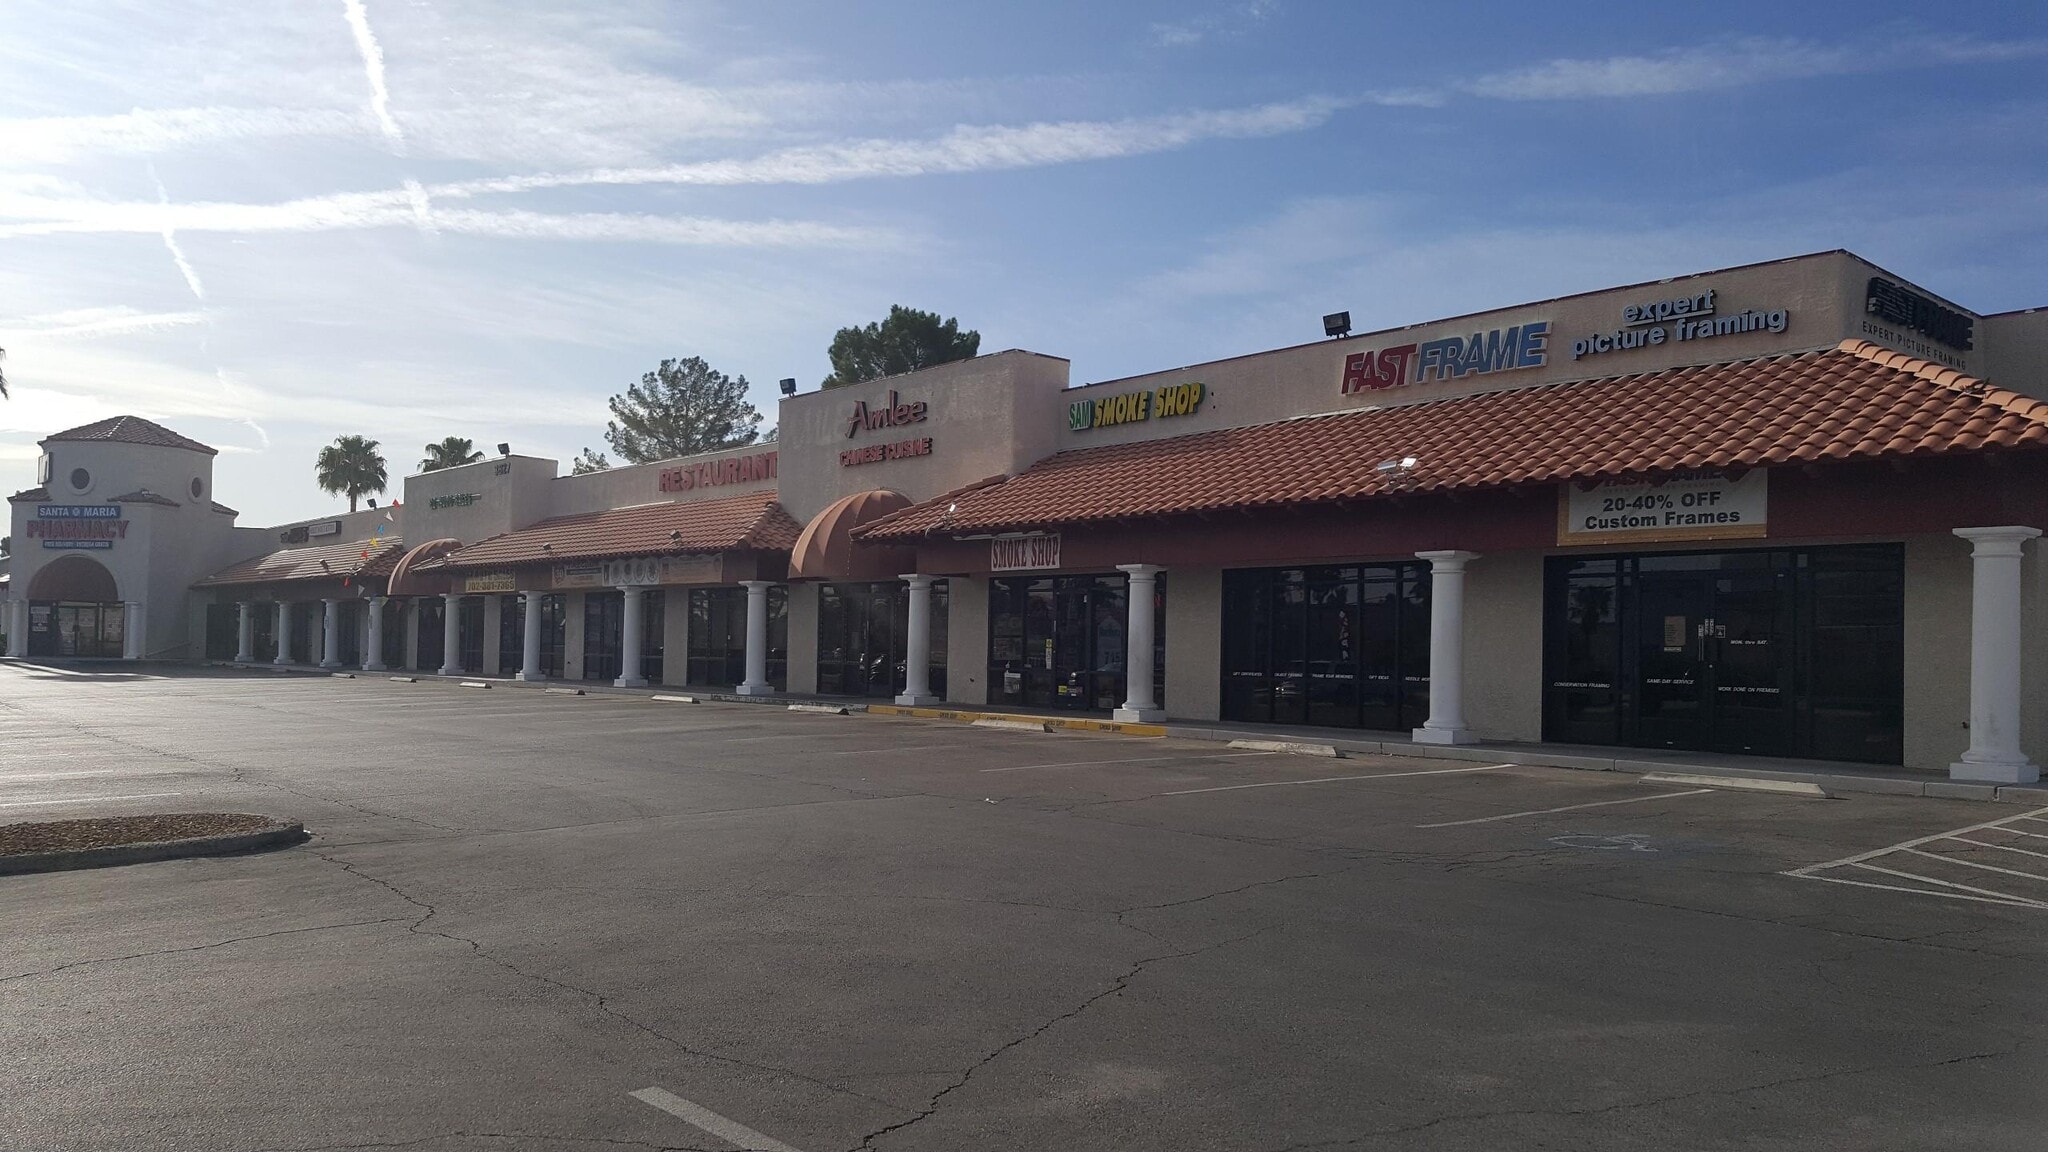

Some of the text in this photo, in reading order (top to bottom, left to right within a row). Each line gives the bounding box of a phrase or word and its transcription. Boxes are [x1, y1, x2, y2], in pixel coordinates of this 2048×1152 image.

[1622, 288, 1715, 321] expert
[1572, 308, 1789, 360] picture framing
[1862, 321, 1966, 370] EXPERT PICTURE FRAMING
[844, 389, 928, 439] Amlee
[1069, 382, 1204, 431] SAM SMOKE SHOP
[885, 437, 933, 460] CUISINE
[658, 451, 778, 492] RESTAURANT
[39, 507, 117, 517] SANTA MARIA
[1602, 491, 1721, 512] 20-40% OFF
[26, 519, 130, 540] PHARMACY
[1585, 511, 1741, 530] Custom Frames
[992, 535, 1059, 568] SMOKE SHOP
